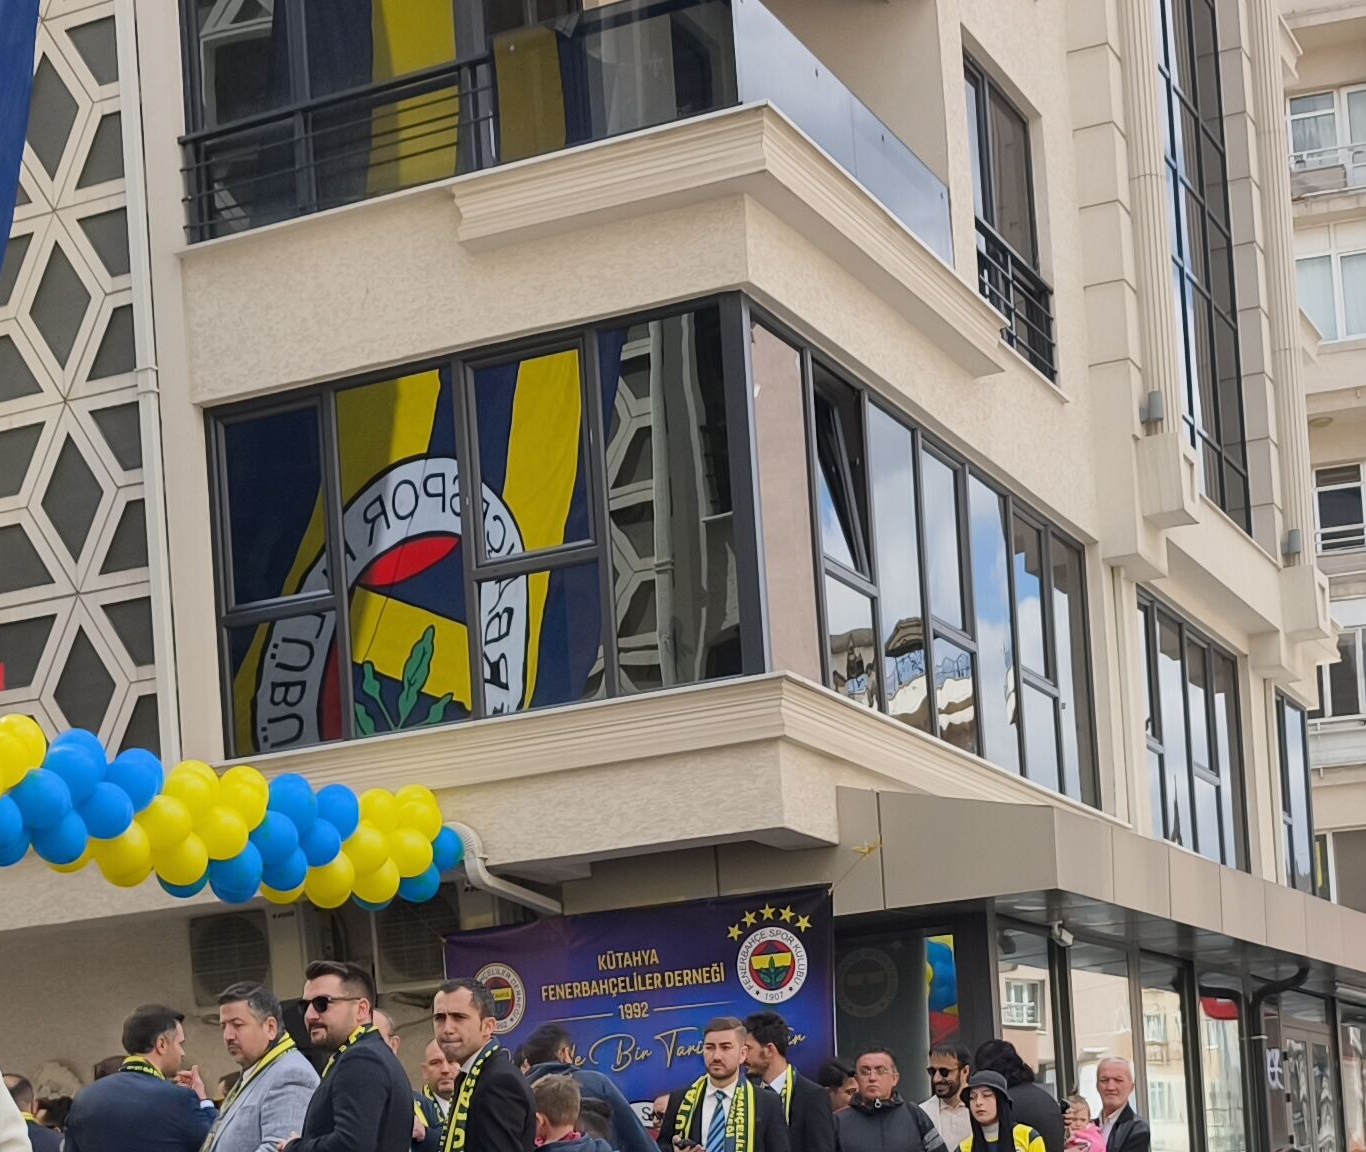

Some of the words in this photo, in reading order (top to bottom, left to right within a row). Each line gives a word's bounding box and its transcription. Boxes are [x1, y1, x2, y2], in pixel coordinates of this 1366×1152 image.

[597, 948, 660, 971] KÜTAHYA
[739, 931, 767, 991] FENERBAHÇE
[768, 929, 795, 945] SPOR
[541, 972, 663, 1002] FENERBAHÇELİLER
[664, 962, 725, 989] DERNEĞİ
[765, 991, 784, 1001] 1907
[618, 1001, 649, 1020] 1992
[589, 1033, 653, 1073] Bir
[654, 1027, 704, 1068] Tari
